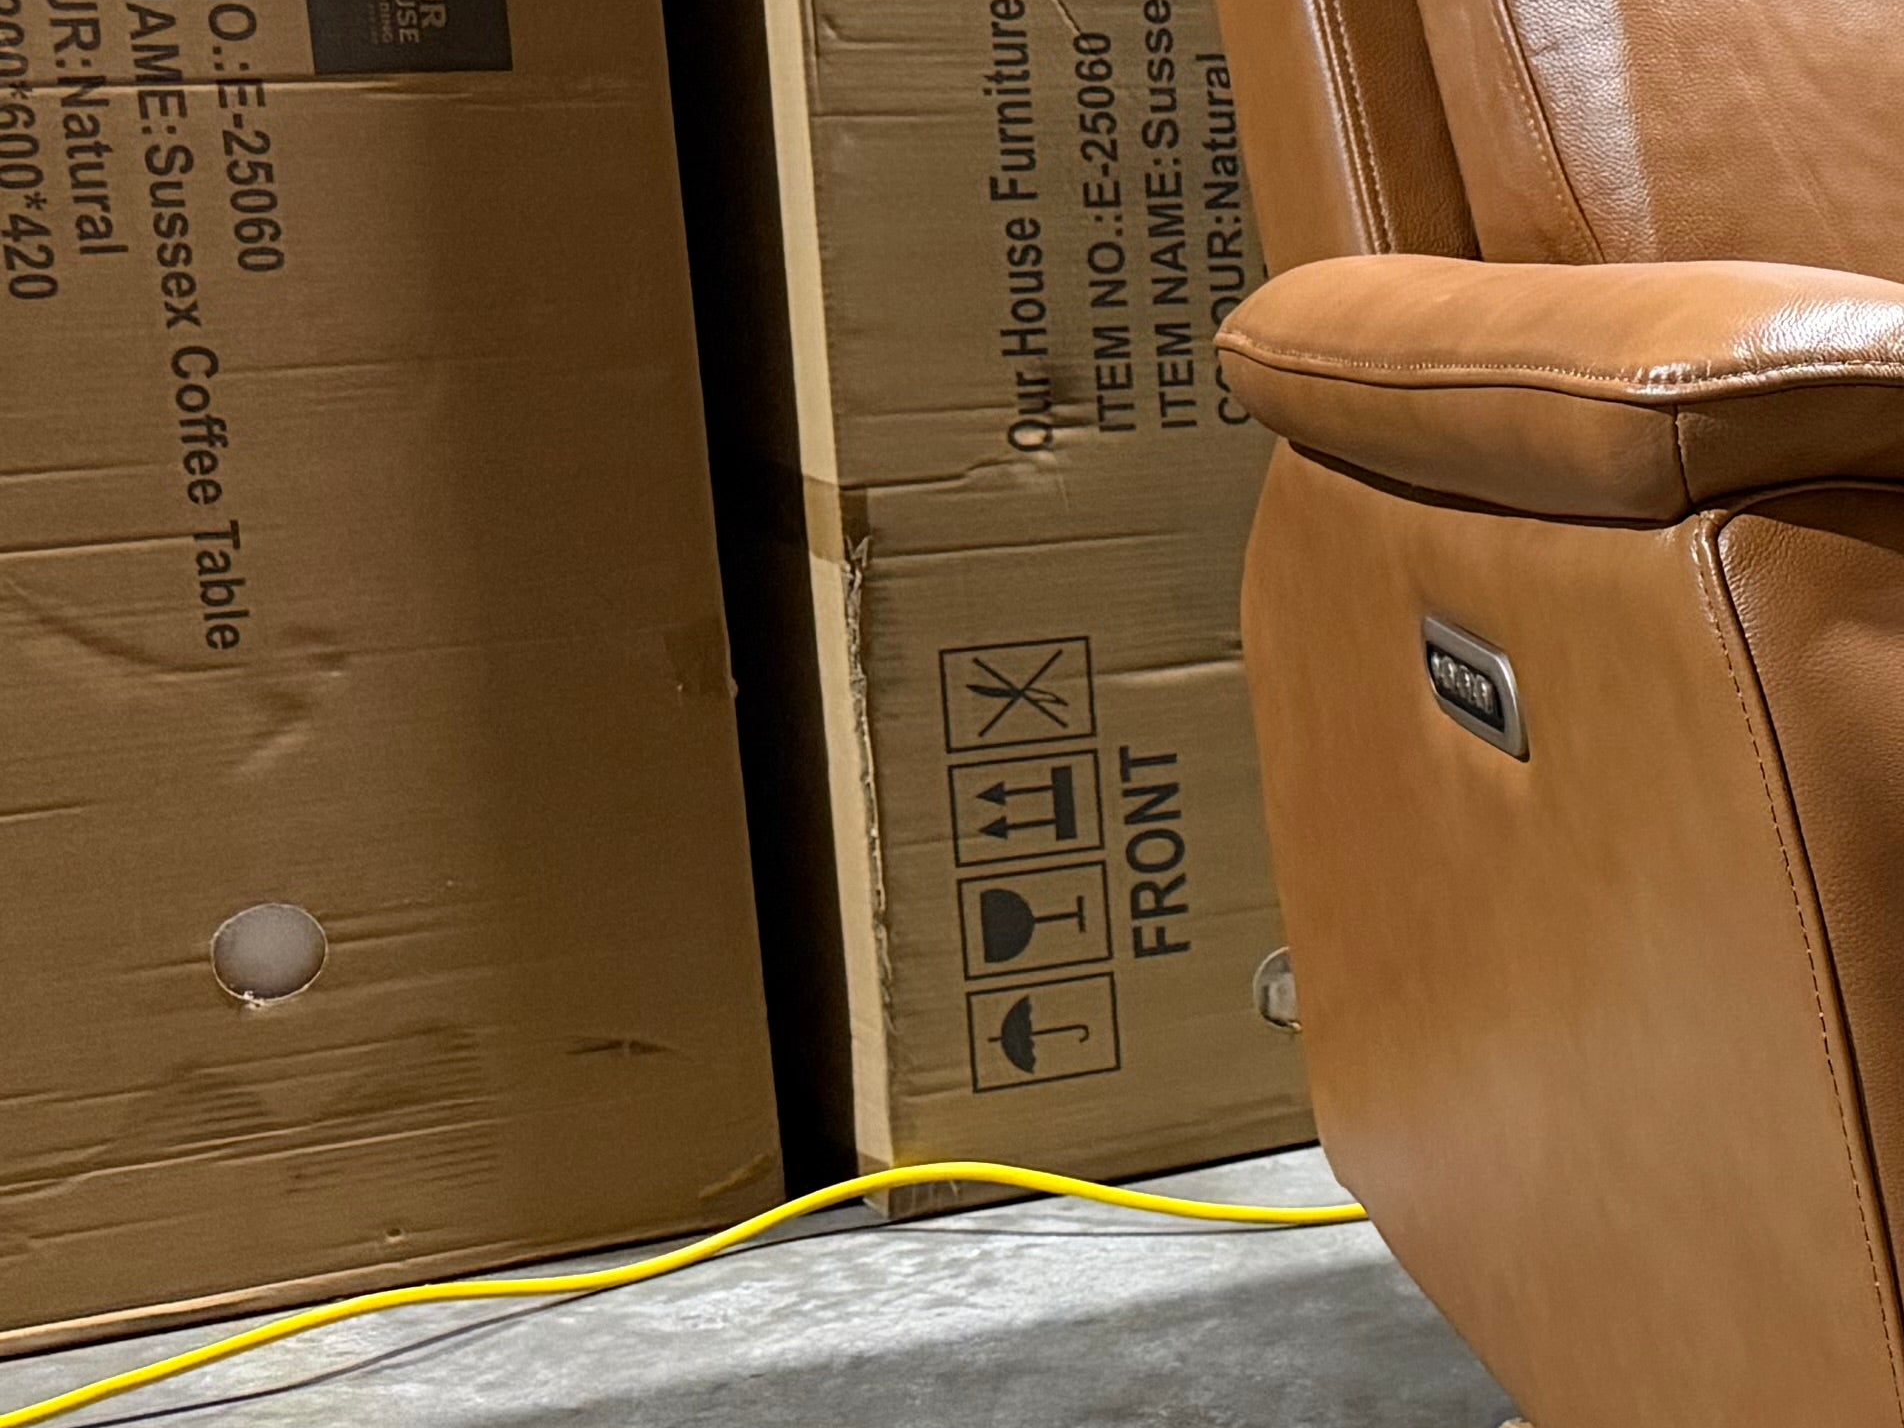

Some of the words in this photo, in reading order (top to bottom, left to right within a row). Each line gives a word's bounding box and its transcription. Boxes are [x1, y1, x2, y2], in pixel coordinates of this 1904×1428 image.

[1073, 32, 1129, 308] NO.:E-25060
[1001, 216, 1049, 357] House
[170, 345, 229, 505] Coffee
[1006, 369, 1053, 453] Our
[1092, 325, 1137, 433] ITEM
[1155, 322, 1198, 430] ITEM
[192, 519, 250, 651] Table
[1119, 745, 1192, 960] FRONT
